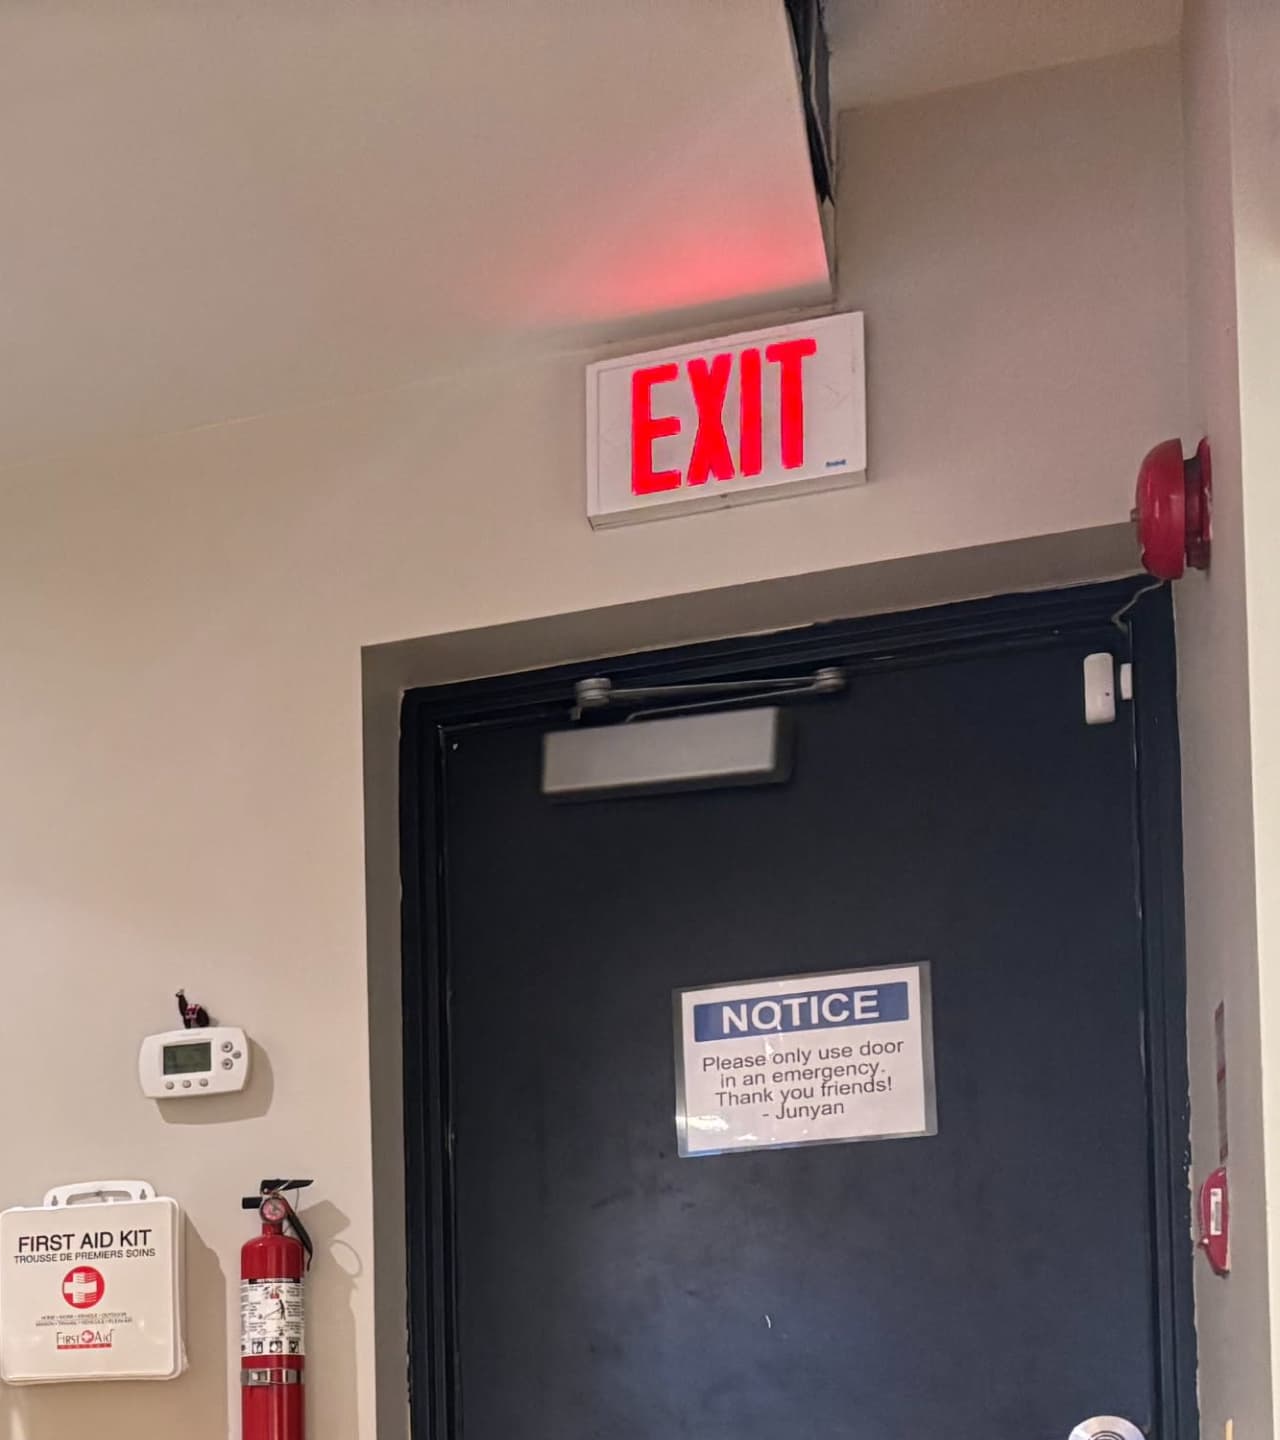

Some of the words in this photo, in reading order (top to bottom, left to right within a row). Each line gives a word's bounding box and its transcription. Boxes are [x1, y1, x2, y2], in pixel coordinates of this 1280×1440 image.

[631, 338, 817, 496] EXIT
[722, 989, 880, 1034] NOTICE
[702, 1053, 767, 1072] Please
[772, 1048, 812, 1066] only
[818, 1045, 853, 1060] use
[859, 1040, 905, 1056] door
[720, 1073, 737, 1088] in
[742, 1072, 765, 1086] an
[772, 1061, 886, 1083] emergency.
[715, 1087, 773, 1107] Thank
[779, 1085, 815, 1104] you
[821, 1076, 893, 1097] friends!
[775, 1102, 845, 1121] Junyan
[18, 1233, 75, 1253] FIRST
[80, 1231, 114, 1249] AID
[120, 1229, 152, 1247] KIT
[14, 1253, 58, 1264] TROUSSE
[60, 1252, 73, 1262] DE
[75, 1250, 124, 1261] PREMIERS
[126, 1248, 156, 1258] SOINS
